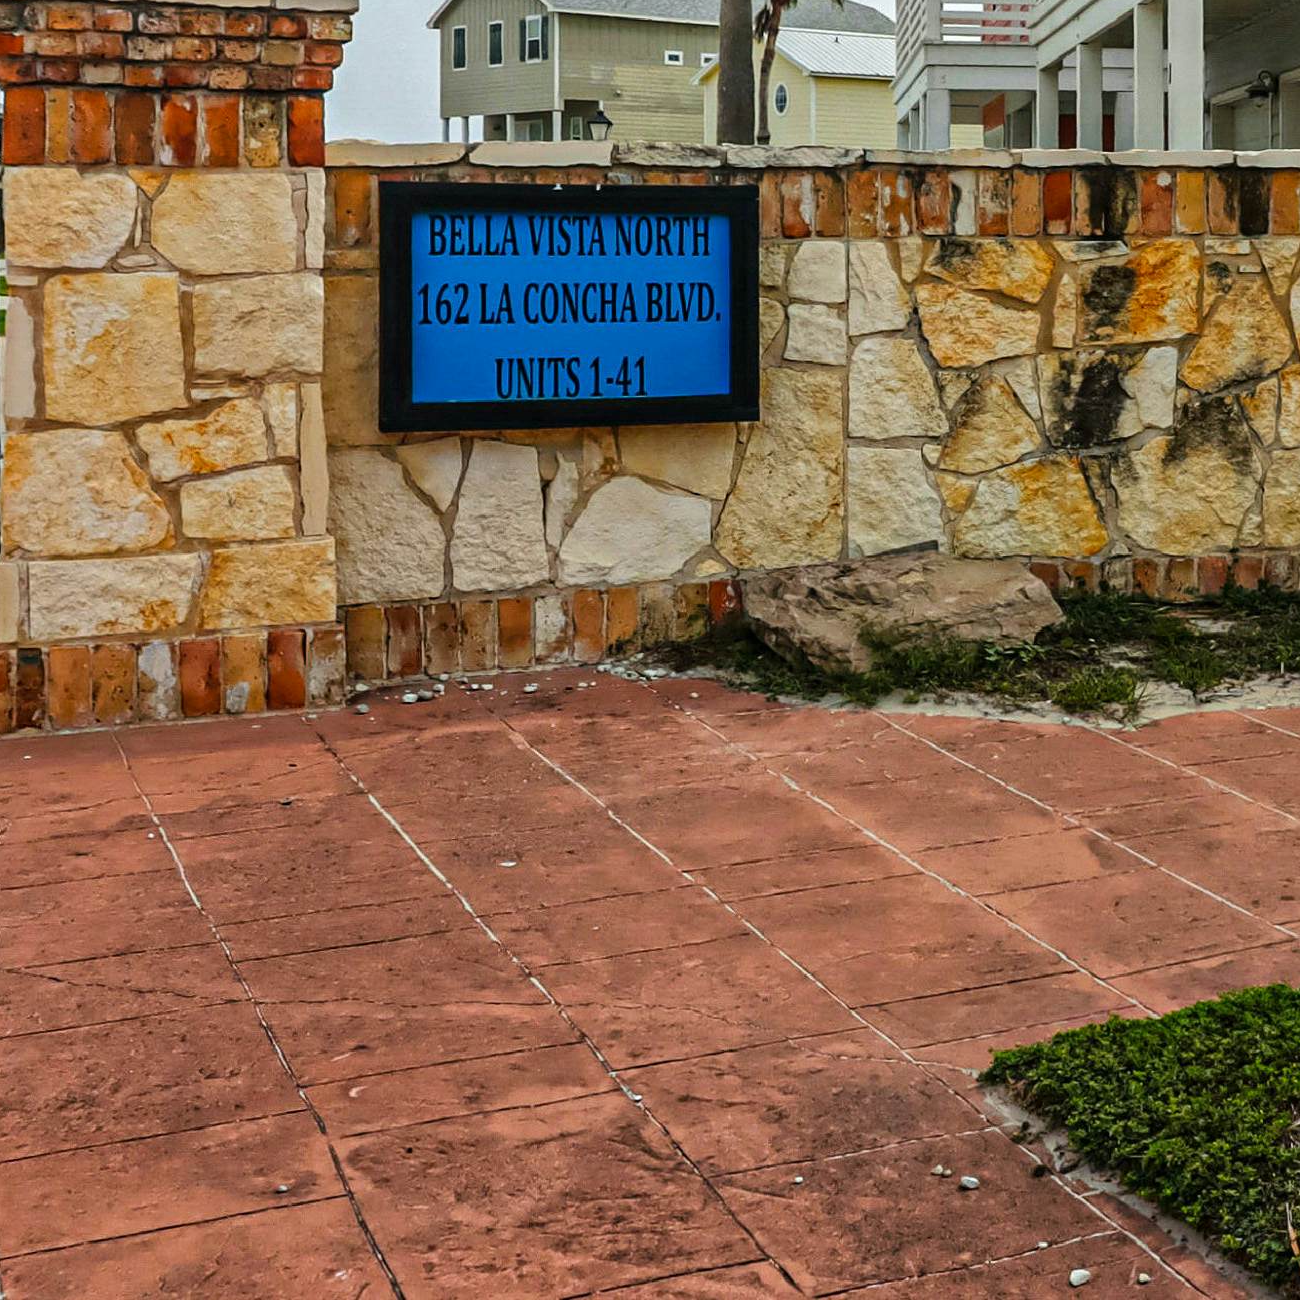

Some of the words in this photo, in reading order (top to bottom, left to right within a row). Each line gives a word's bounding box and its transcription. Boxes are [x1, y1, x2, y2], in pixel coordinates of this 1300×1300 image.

[428, 215, 518, 256] BELLA
[528, 214, 605, 256] VISTA
[614, 215, 710, 257] NORTH
[417, 282, 469, 325] 162
[478, 283, 516, 324] LA
[523, 282, 638, 324] CONCHA
[646, 281, 721, 323] BLVD.
[495, 356, 580, 399] UNITS
[589, 355, 648, 397] 1-41
